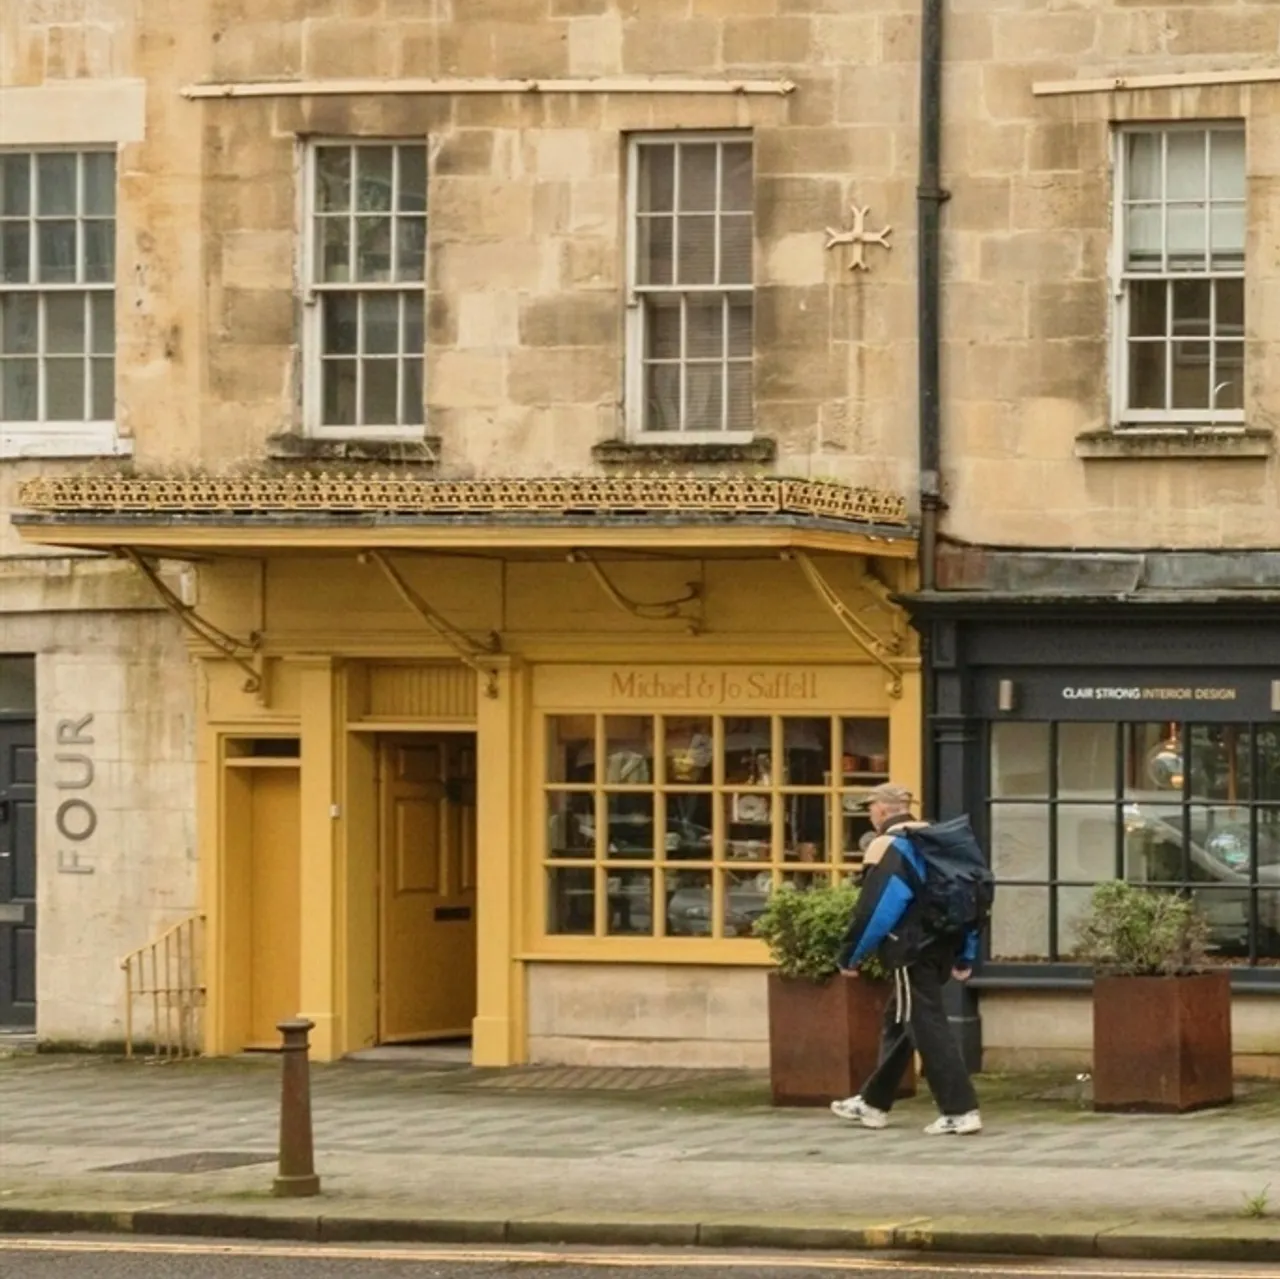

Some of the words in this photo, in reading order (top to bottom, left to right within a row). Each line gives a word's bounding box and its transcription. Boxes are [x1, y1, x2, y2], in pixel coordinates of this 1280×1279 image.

[611, 671, 692, 699] Michael
[696, 674, 714, 698] &
[718, 672, 742, 704] Jo
[747, 672, 818, 699] Saffell
[1062, 687, 1093, 699] CLAIR
[1095, 687, 1142, 699] STRONG
[1142, 688, 1193, 699] INTERIOR
[1194, 688, 1236, 700] DESIGN
[55, 713, 97, 875] FOUR
